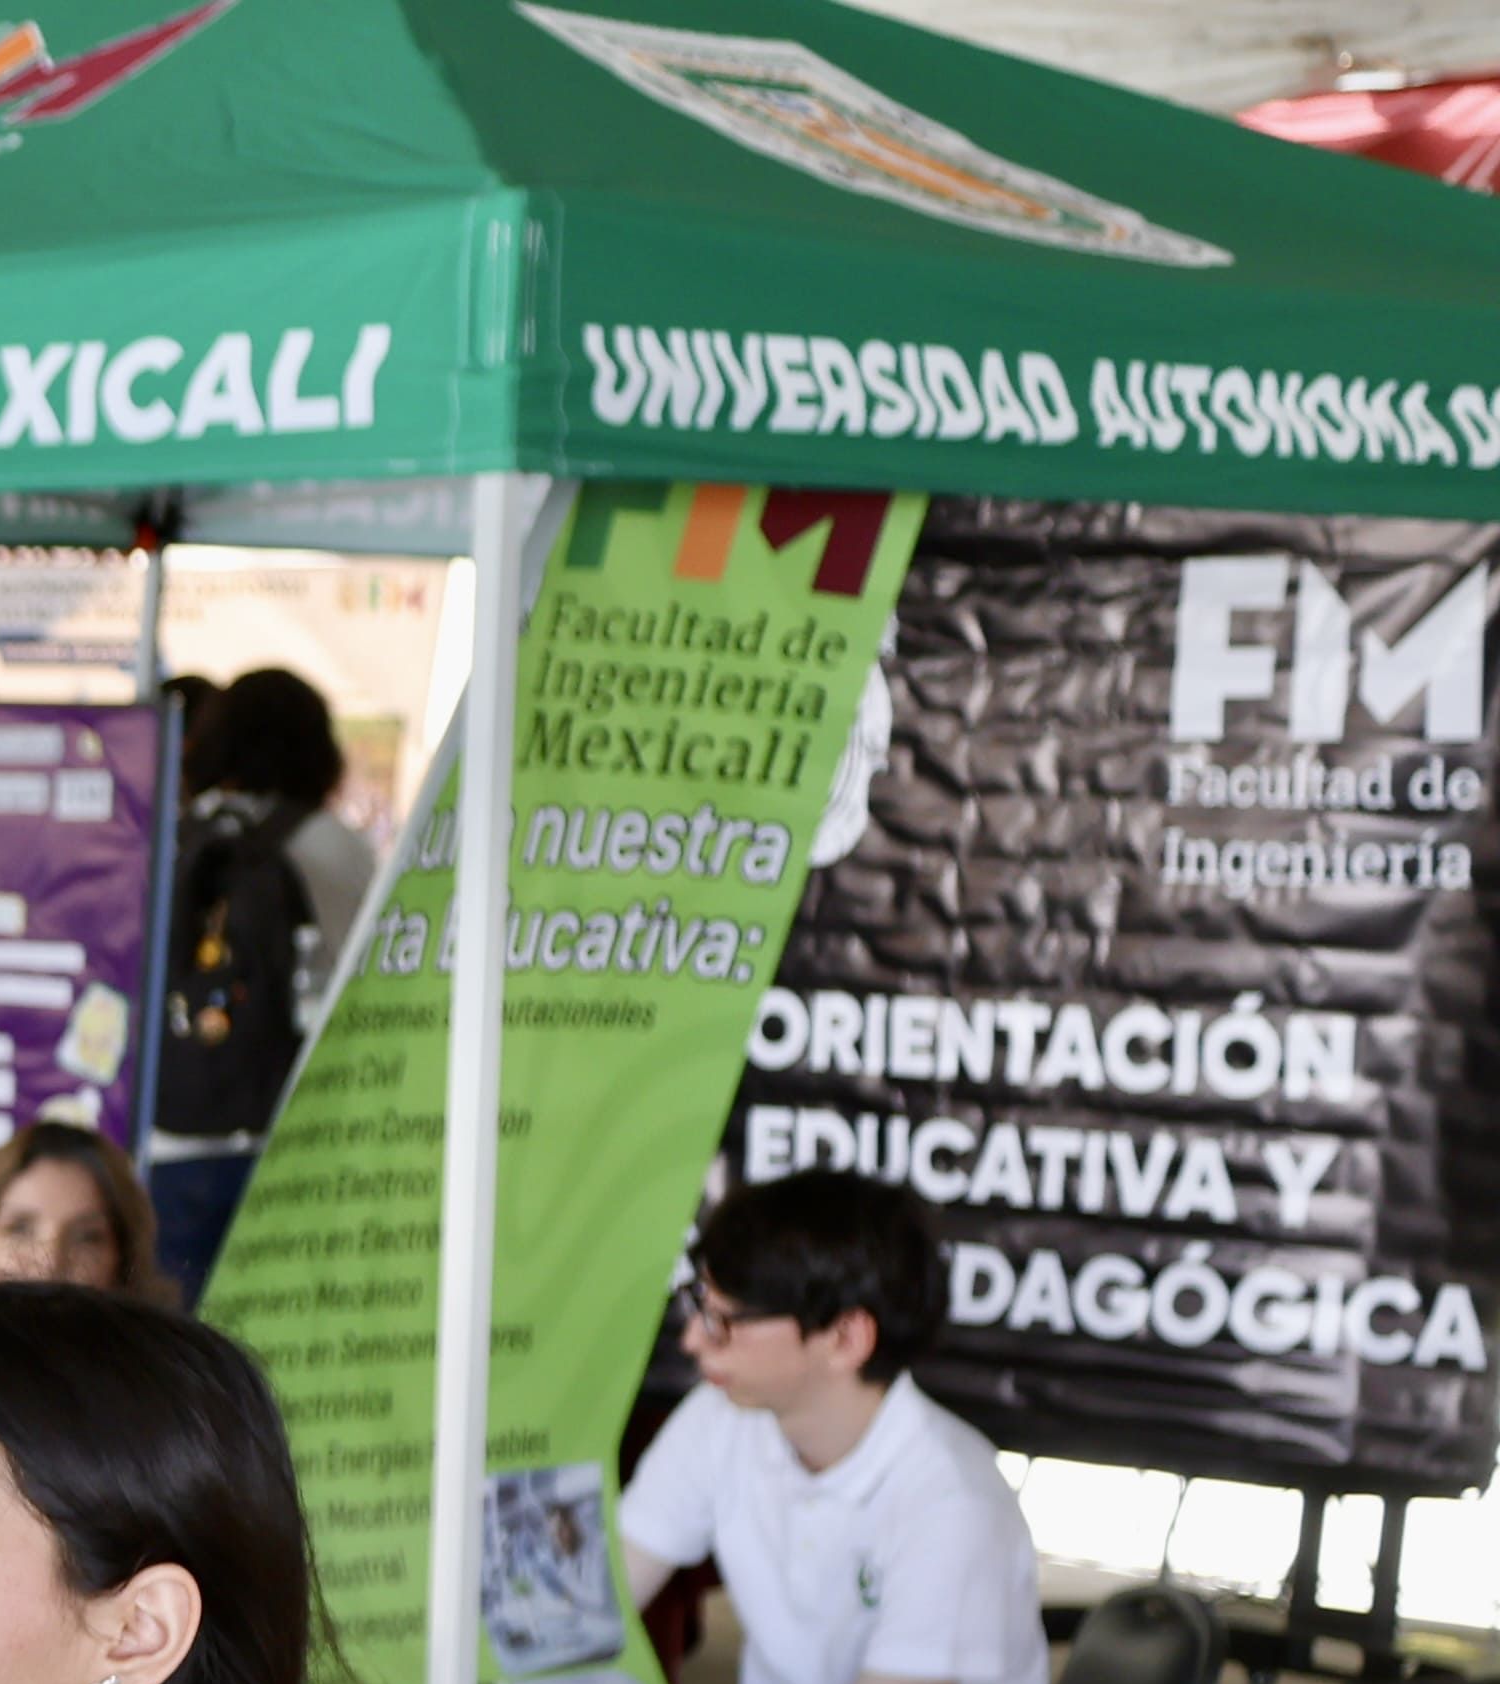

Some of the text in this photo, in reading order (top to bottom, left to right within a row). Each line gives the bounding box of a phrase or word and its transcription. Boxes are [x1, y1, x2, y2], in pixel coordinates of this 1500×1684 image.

[582, 323, 1500, 470] UNIVERSIDAD AUTONOMA D
[549, 590, 849, 668] Facultad de
[517, 706, 813, 789] Mexicali
[1167, 751, 1484, 813] Facultad de
[521, 801, 793, 885] nuestra
[1160, 825, 1475, 902] Ingeniería
[435, 888, 767, 984] ucativa:
[746, 988, 1357, 1101] ORIENTACIÓN
[745, 1103, 1342, 1230] EDUCATIVA Y
[942, 1239, 1490, 1371] DAGÓGICA
